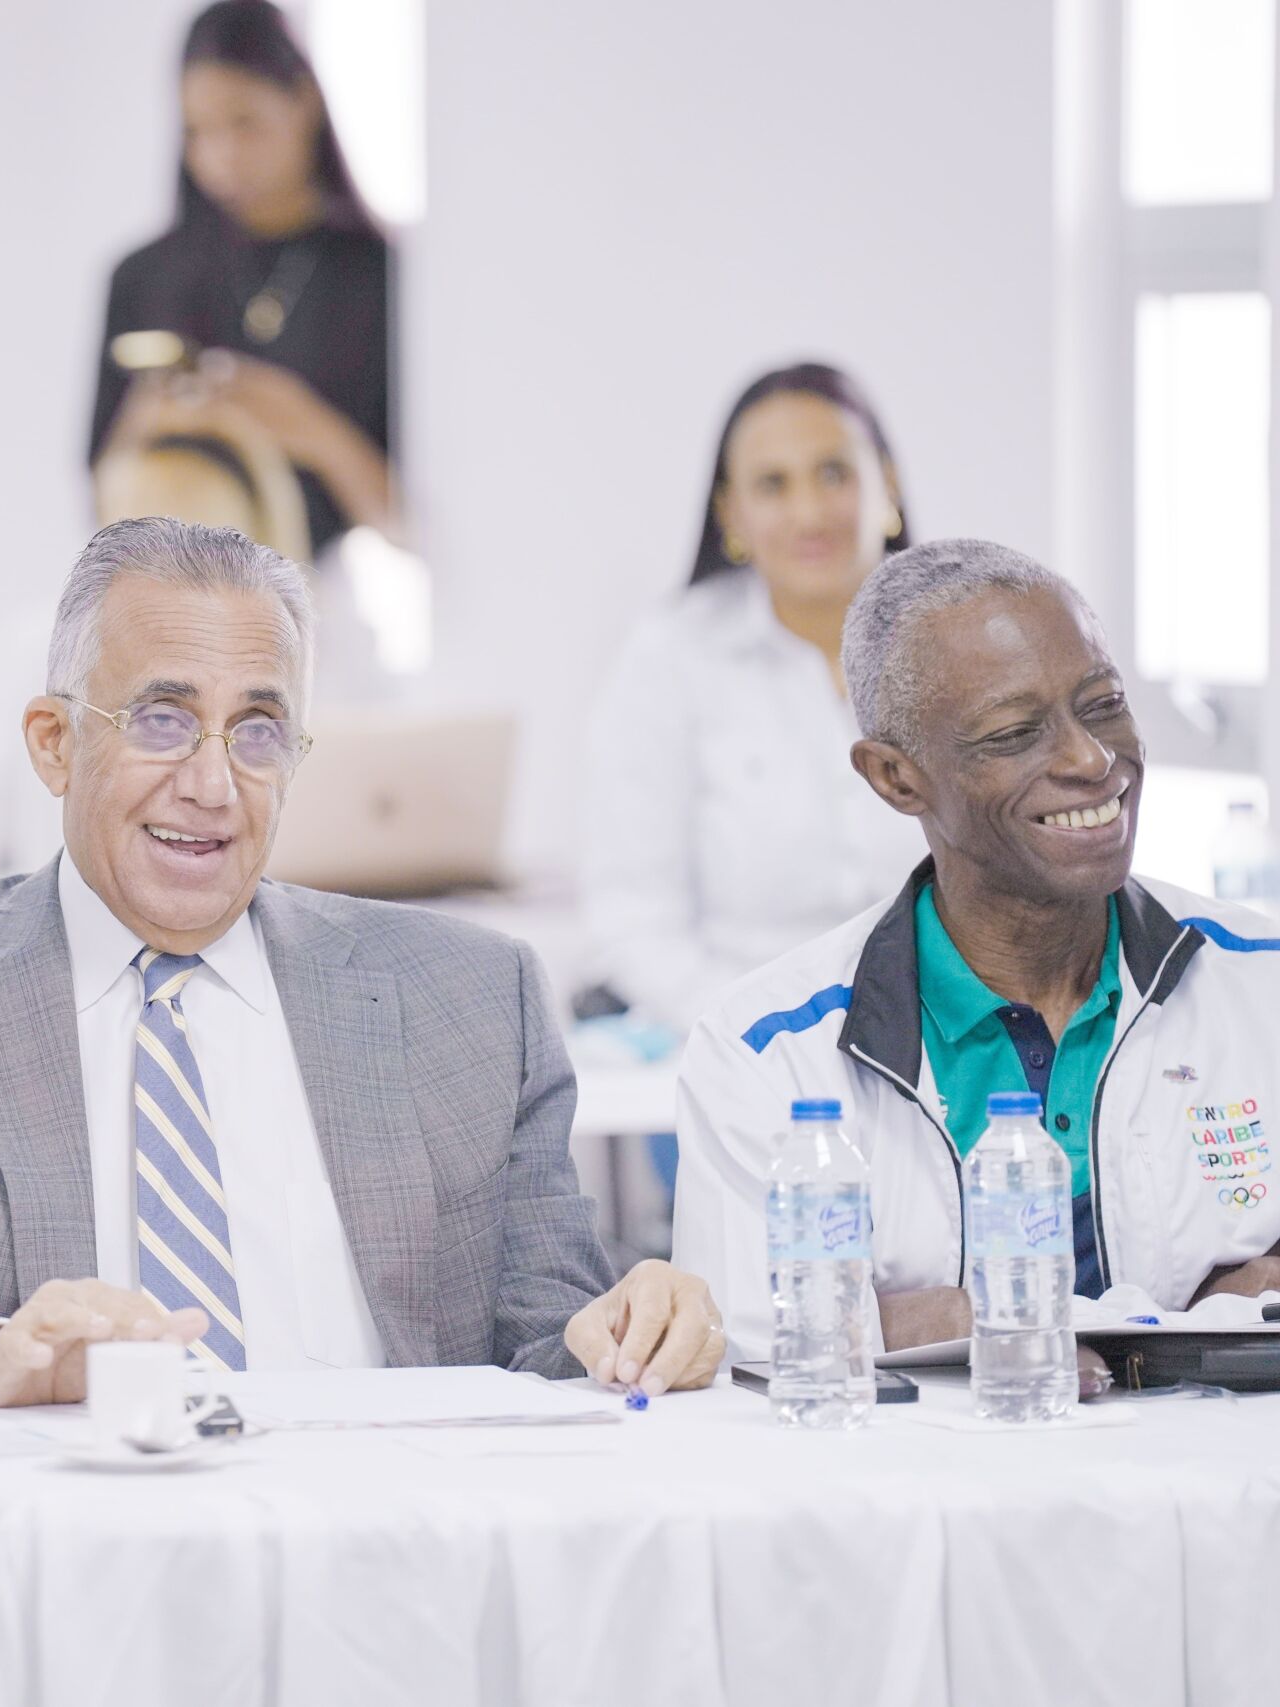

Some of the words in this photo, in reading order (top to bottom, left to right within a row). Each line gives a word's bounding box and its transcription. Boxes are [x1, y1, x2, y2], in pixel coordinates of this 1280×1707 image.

[1186, 1098, 1258, 1121] CENTRO
[1192, 1120, 1264, 1146] CARIBE
[1198, 1142, 1269, 1167] SPORTS
